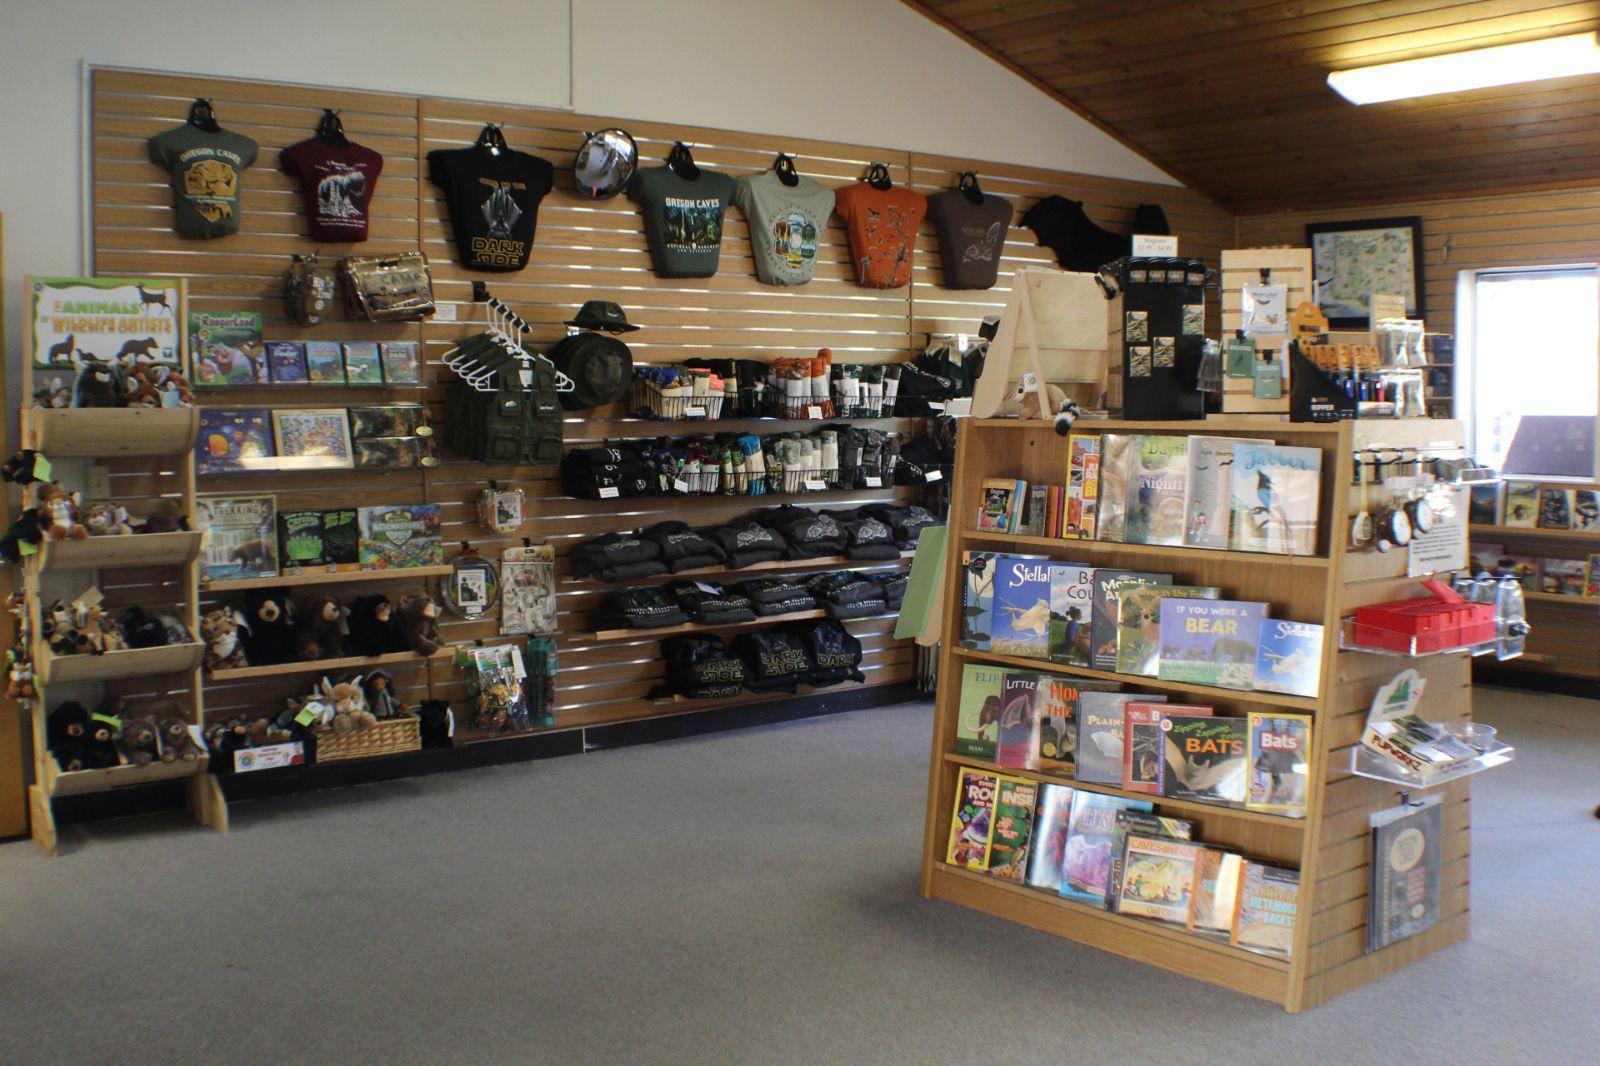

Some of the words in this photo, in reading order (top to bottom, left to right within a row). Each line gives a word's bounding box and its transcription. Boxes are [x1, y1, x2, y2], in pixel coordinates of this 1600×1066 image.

[665, 197, 696, 208] OREGON
[696, 198, 720, 208] CAVES
[472, 236, 525, 256] DARK
[471, 252, 520, 266] SIDE
[62, 300, 140, 314] ANIMALS
[53, 317, 116, 333] WILDLIFE
[119, 317, 173, 333] ARTISTS
[1176, 605, 1186, 614] IF
[1189, 606, 1208, 615] YOU
[1211, 607, 1237, 616] WERE
[1240, 609, 1248, 617] A
[1185, 618, 1238, 636] BEAR
[761, 648, 807, 666] DARK
[817, 653, 855, 668] DARK
[1006, 680, 1036, 690] LITTLE
[1046, 705, 1073, 718] THE
[1185, 737, 1244, 756] BATS
[1260, 732, 1297, 750] Bats
